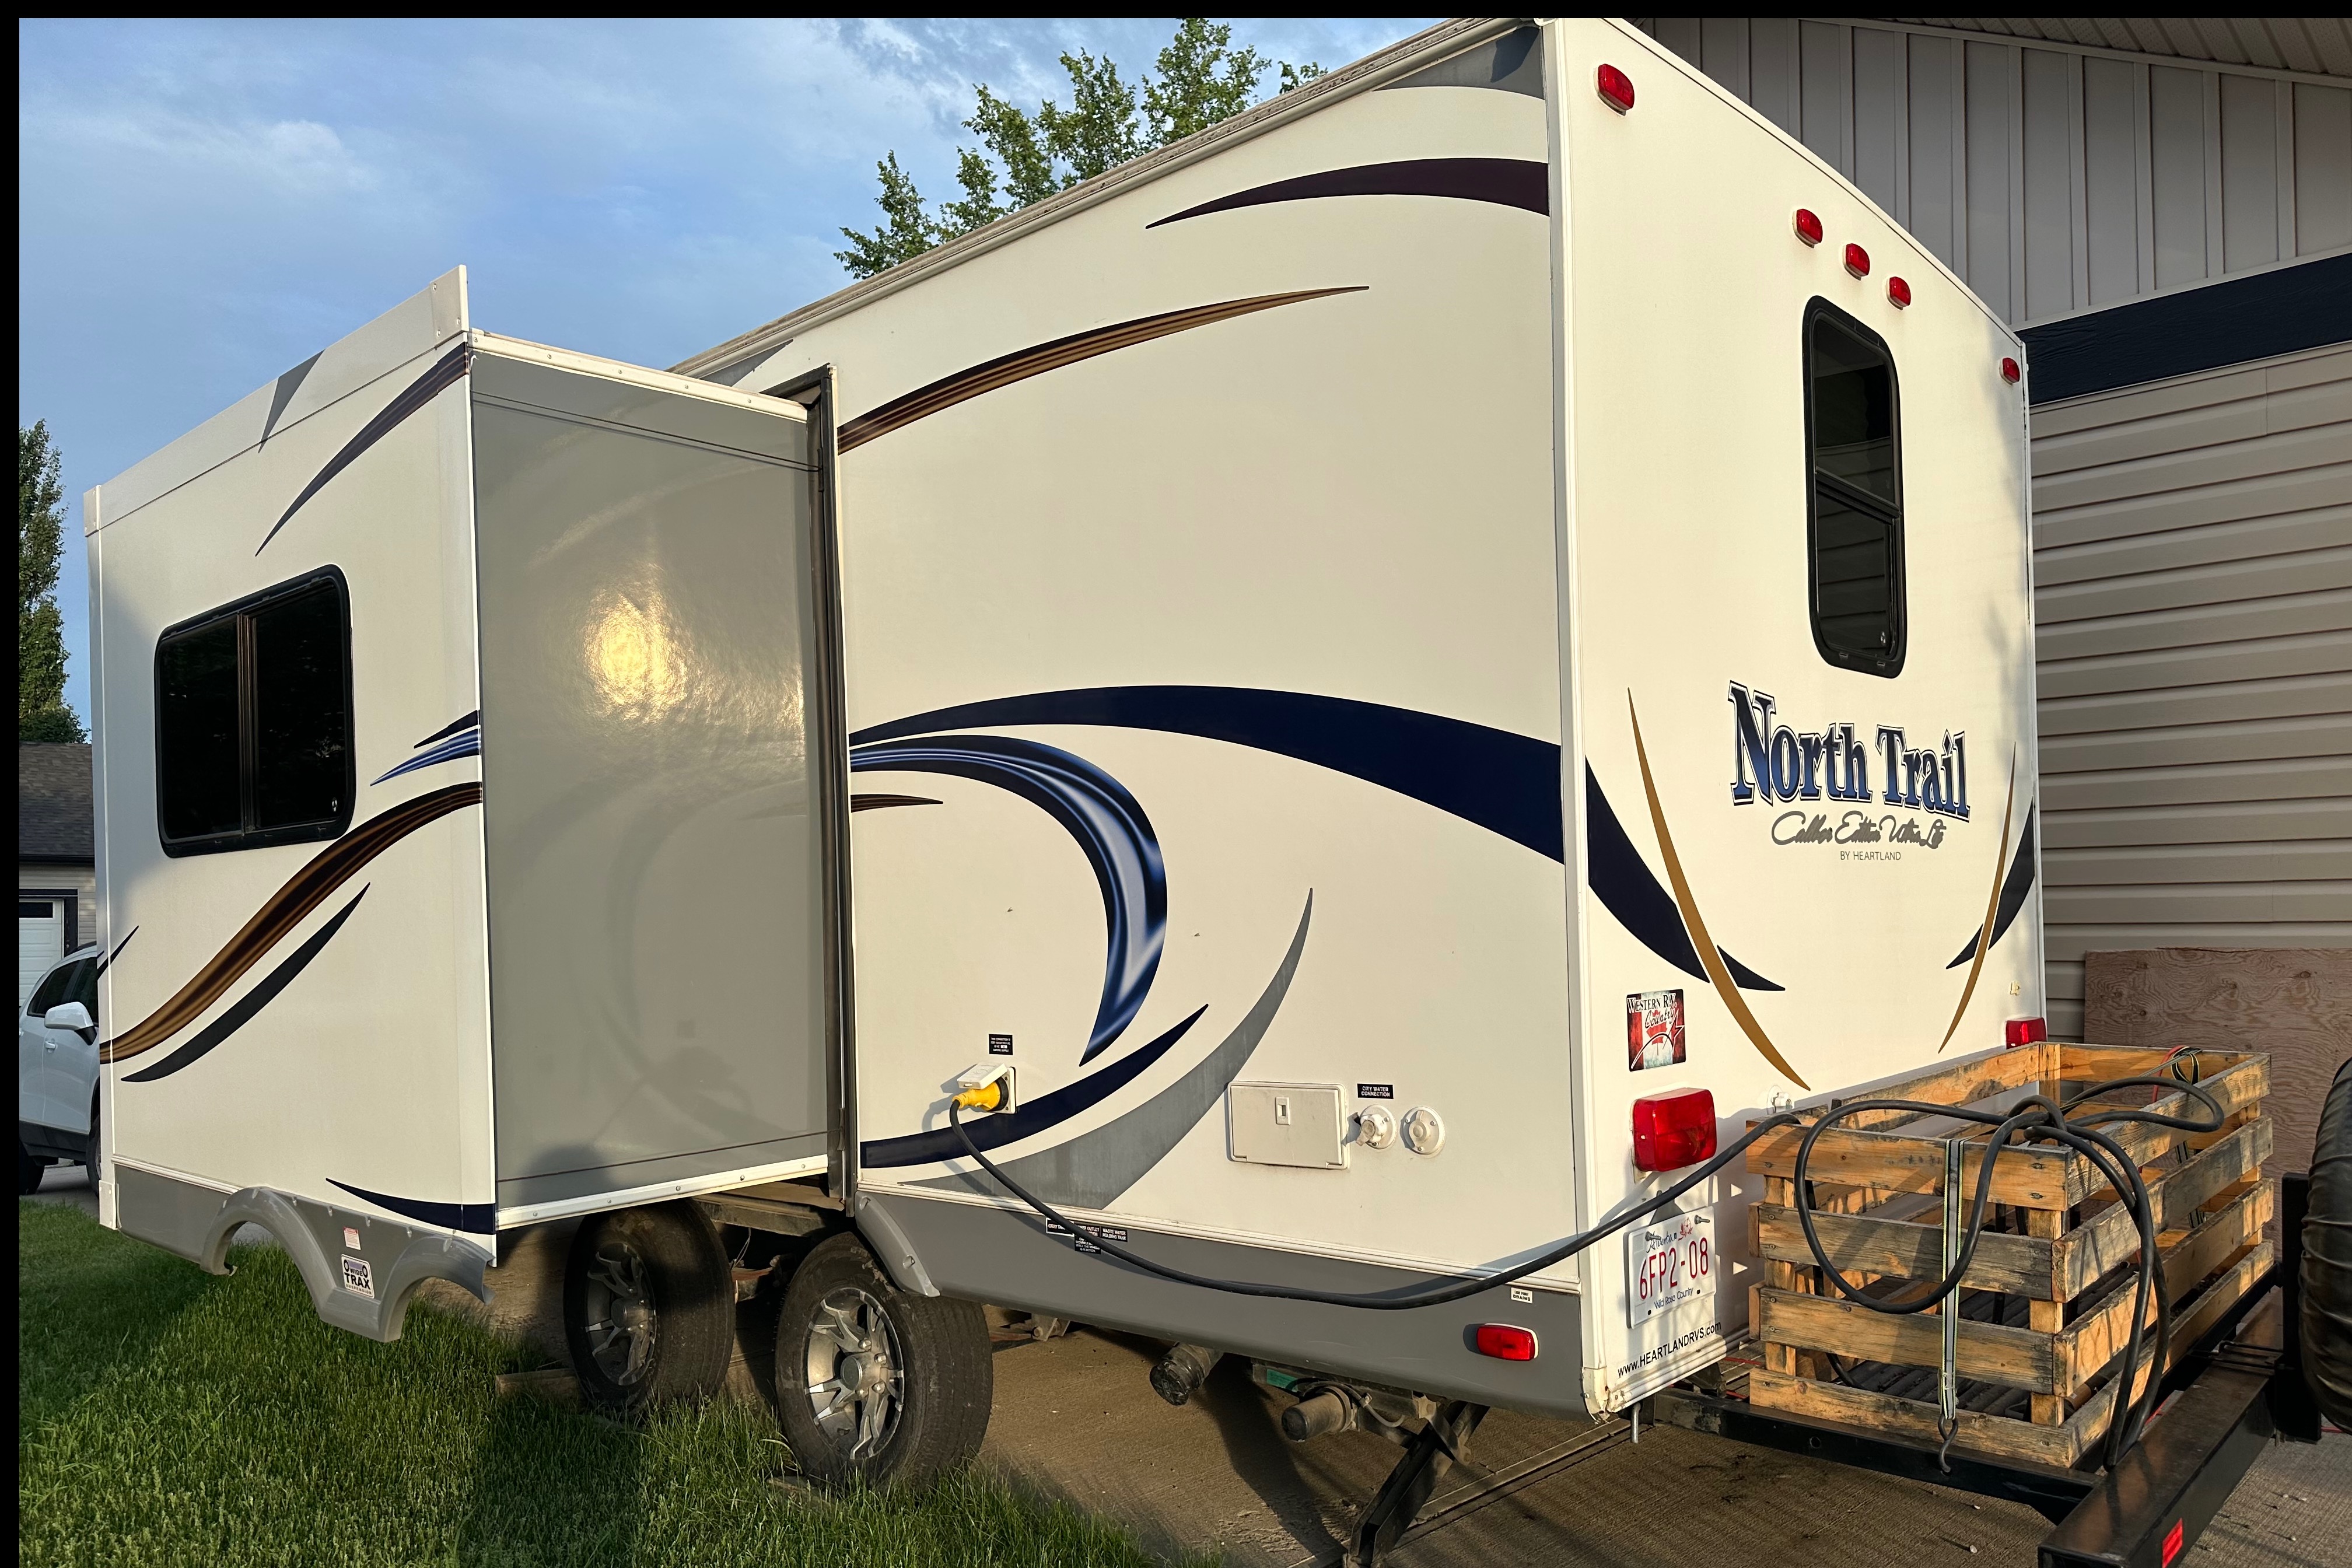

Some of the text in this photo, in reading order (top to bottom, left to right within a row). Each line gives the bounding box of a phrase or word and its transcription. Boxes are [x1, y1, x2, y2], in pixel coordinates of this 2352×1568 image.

[1728, 680, 1970, 822] North Trail
[1840, 851, 1901, 860] BY HEARTLAND
[1626, 997, 1661, 1014] WESTERN
[1645, 1008, 1675, 1028] Country
[350, 1268, 363, 1276] WIDE
[1640, 1237, 1709, 1300] 6FP2-08
[344, 1272, 371, 1290] TRAX
[1654, 1298, 1664, 1309] Wild
[1618, 1322, 1721, 1378] www.HEARTLANDRVS.com
